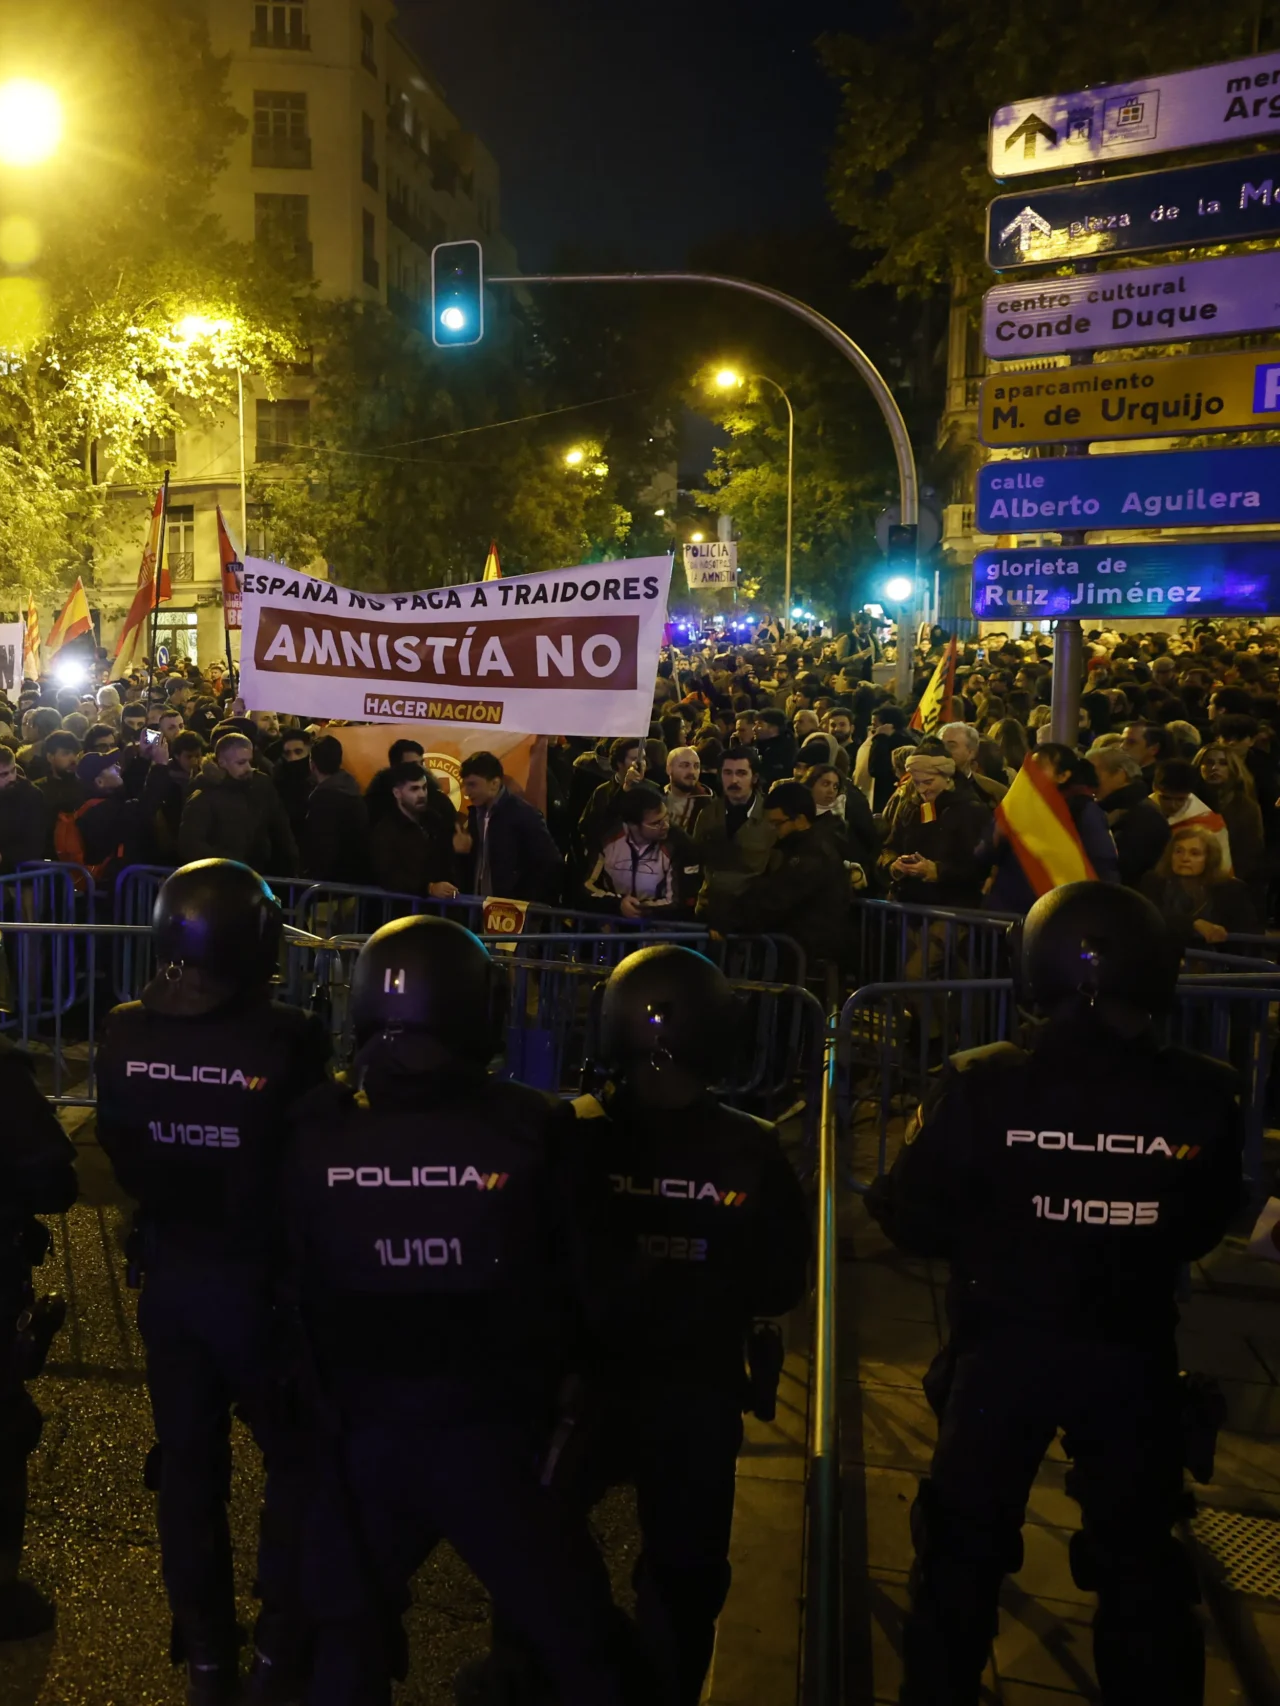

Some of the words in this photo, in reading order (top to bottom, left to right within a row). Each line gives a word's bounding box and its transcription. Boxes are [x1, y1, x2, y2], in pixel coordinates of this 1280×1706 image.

[1070, 213, 1131, 238] plaza
[1150, 204, 1179, 222] de
[1198, 199, 1220, 216] la
[997, 294, 1070, 314] centro
[1087, 277, 1186, 304] cultural
[996, 315, 1091, 341] Conde
[1112, 302, 1218, 330] Duque
[994, 374, 1154, 401] aparcamiento
[993, 407, 1025, 430] M.
[1044, 405, 1081, 427] de
[1101, 393, 1224, 424] Urquijo
[990, 473, 1045, 490] calle
[990, 495, 1100, 519] Alberto
[1121, 488, 1260, 516] Aguilera
[685, 544, 729, 558] POLICIA
[986, 558, 1079, 580] glorieta
[1097, 557, 1127, 574] de
[243, 574, 338, 605] ESPAÑA
[391, 589, 461, 611] PAGA
[470, 587, 488, 608] A
[498, 576, 659, 606] TRAIDORES
[985, 584, 1048, 606] Ruiz
[1071, 581, 1201, 605] Jiménez
[263, 626, 514, 677] AMNISTÍA
[535, 633, 622, 678] NO
[487, 914, 516, 933] NO
[126, 1060, 248, 1089] POLICIA
[148, 1120, 241, 1148] 1U1025
[1006, 1129, 1173, 1158] POLICIA
[327, 1165, 485, 1189] POLICIA
[608, 1173, 721, 1203] OLICIA
[1032, 1195, 1160, 1226] 1U1035
[374, 1237, 463, 1266] 1U101
